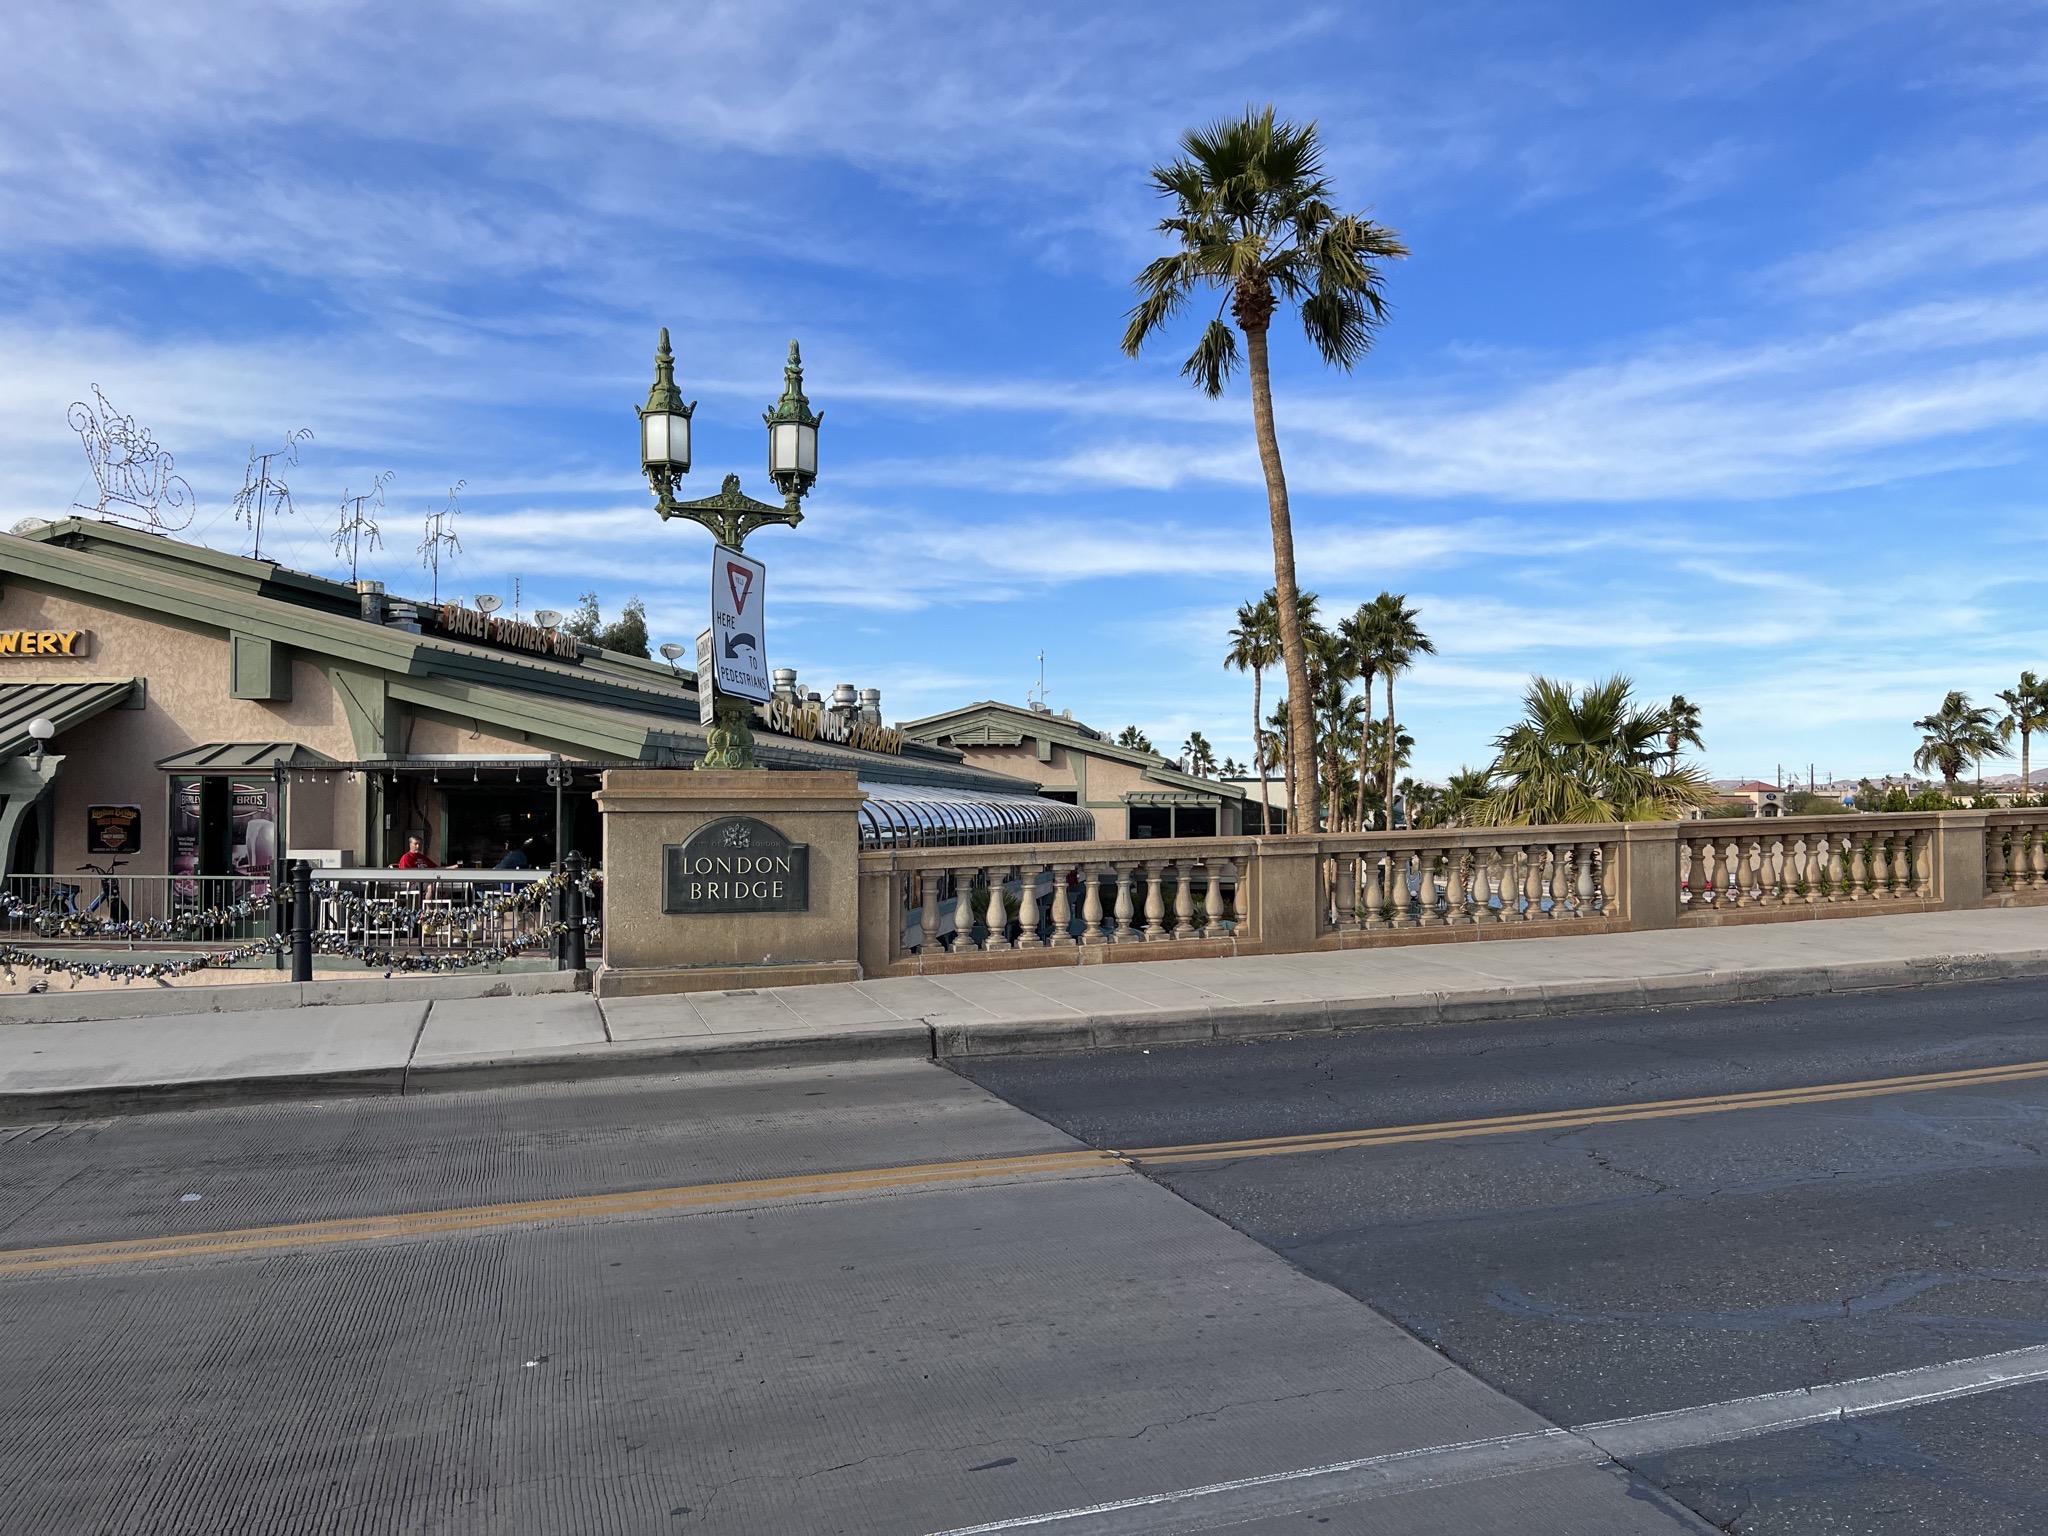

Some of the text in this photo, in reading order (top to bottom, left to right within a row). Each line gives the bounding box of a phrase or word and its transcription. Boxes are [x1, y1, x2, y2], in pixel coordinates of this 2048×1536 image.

[717, 611, 736, 630] HERE
[0, 630, 77, 653] WERY
[448, 604, 578, 659] BARLEY BROTHERS GRILL
[749, 655, 758, 670] TO
[721, 666, 767, 691] PEDESTRIANS
[766, 700, 906, 756] ISLAND MALL & BREWERY
[236, 795, 265, 806] BROS.
[683, 856, 791, 875] LONDON
[690, 880, 783, 900] BRIDGE
